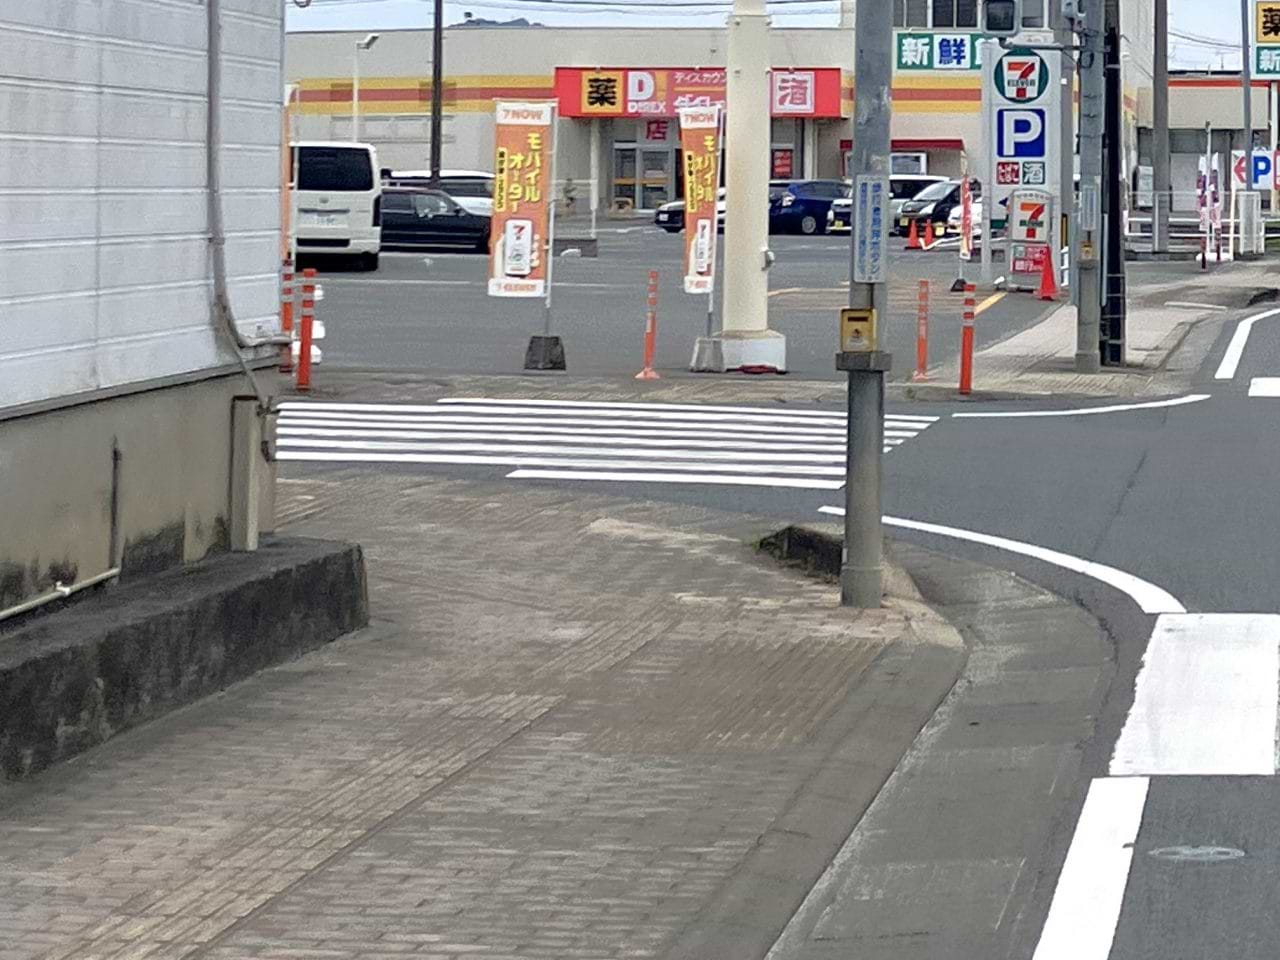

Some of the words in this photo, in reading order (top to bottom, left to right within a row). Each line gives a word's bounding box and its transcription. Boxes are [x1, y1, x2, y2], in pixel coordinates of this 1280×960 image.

[588, 78, 617, 105] 薬
[1003, 111, 1042, 156] P
[1023, 163, 1043, 182] 酒
[1253, 156, 1271, 184] P
